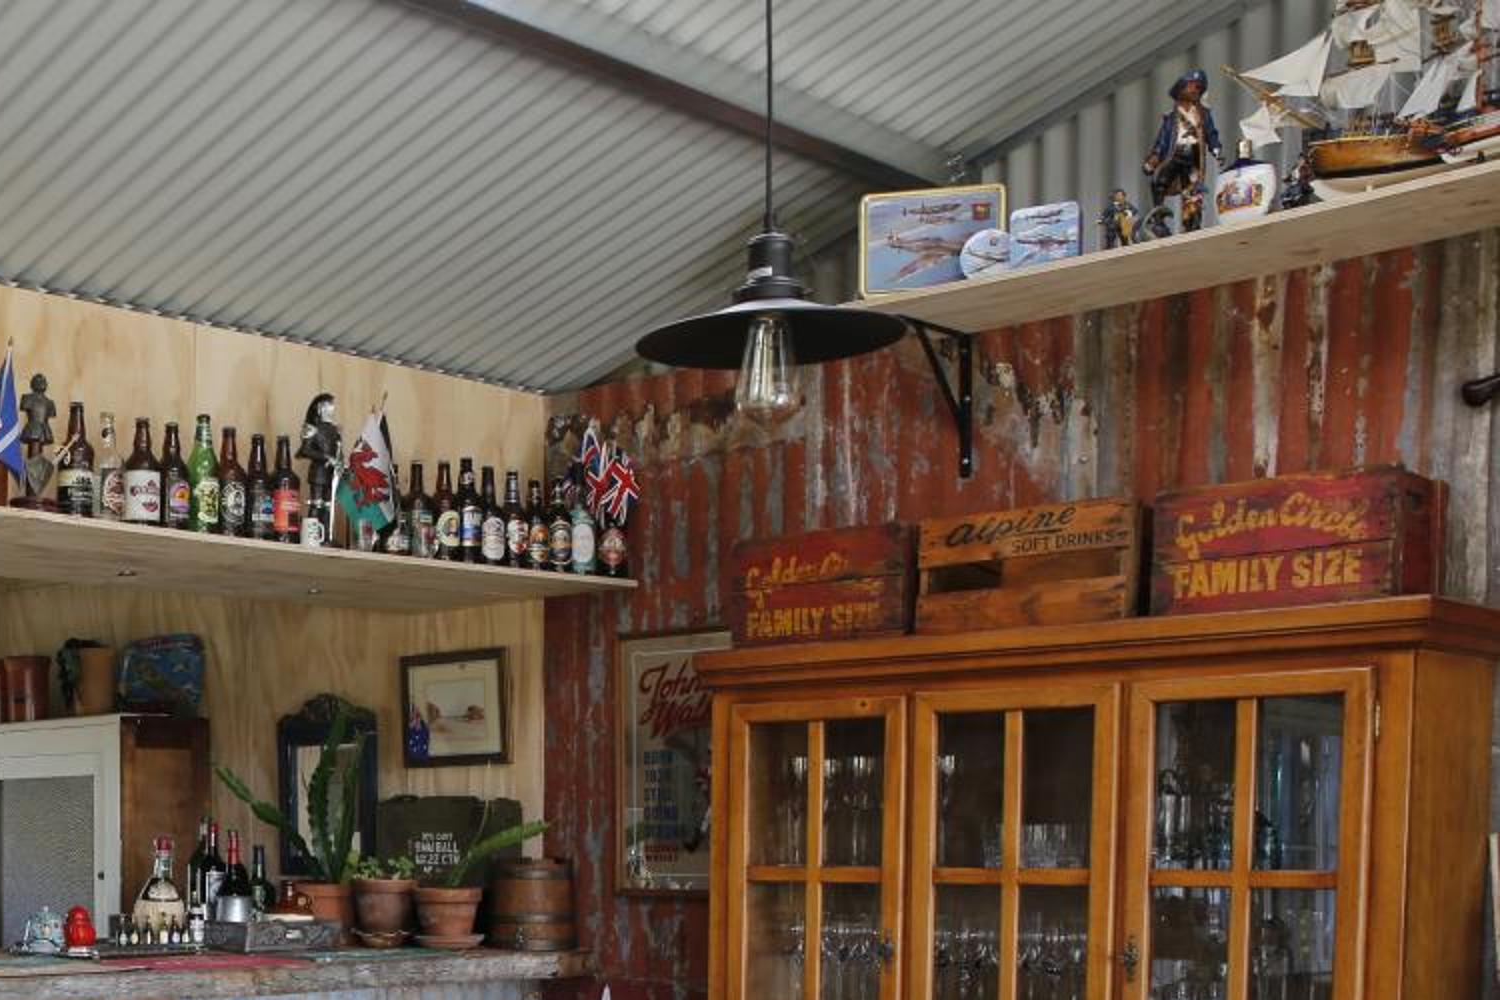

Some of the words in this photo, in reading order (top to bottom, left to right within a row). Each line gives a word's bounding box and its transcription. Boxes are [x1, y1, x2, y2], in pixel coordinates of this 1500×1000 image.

[1011, 536, 1051, 555] SOFT
[1055, 528, 1115, 550] DRINKS
[1175, 499, 1280, 560] Golden
[1169, 555, 1285, 600] FAMILY
[1291, 548, 1363, 589] SIZE
[746, 605, 825, 641] FAMILY
